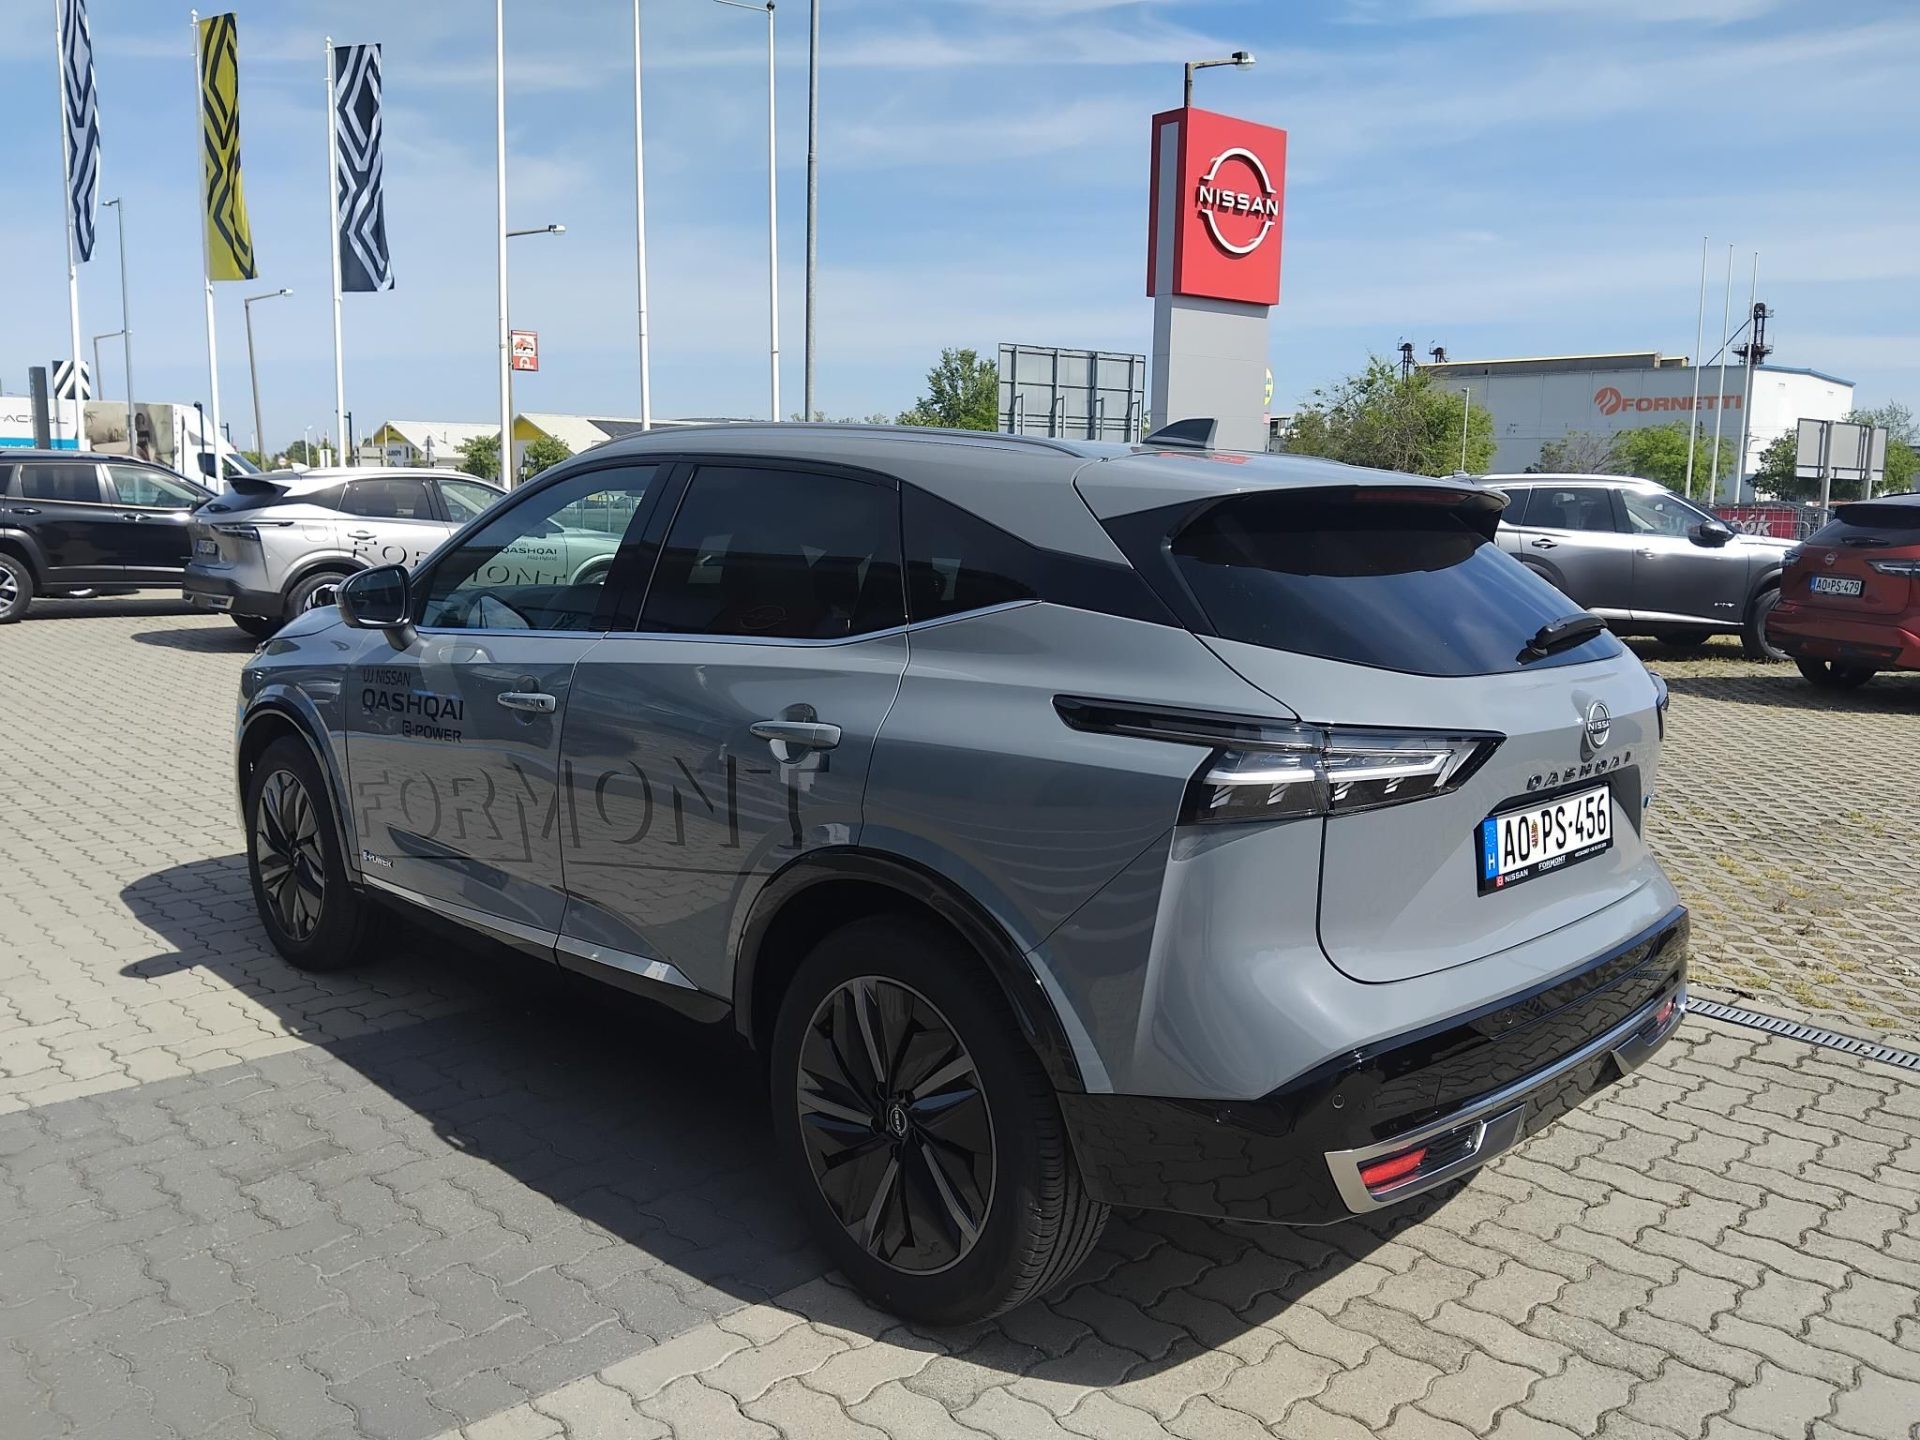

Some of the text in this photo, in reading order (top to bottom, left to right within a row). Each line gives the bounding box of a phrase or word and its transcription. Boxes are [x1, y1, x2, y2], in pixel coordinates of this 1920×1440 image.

[1199, 185, 1279, 216] NISSAN
[1622, 394, 1742, 413] FORNETTI
[502, 546, 557, 555] QASHQAI
[376, 669, 411, 687] NISSAN
[362, 688, 464, 722] QASHQAI
[358, 755, 830, 862] FORMONT
[1503, 816, 1531, 868] AO
[1487, 852, 1496, 871] H
[1504, 855, 1567, 883] NISSAN FORMONT
